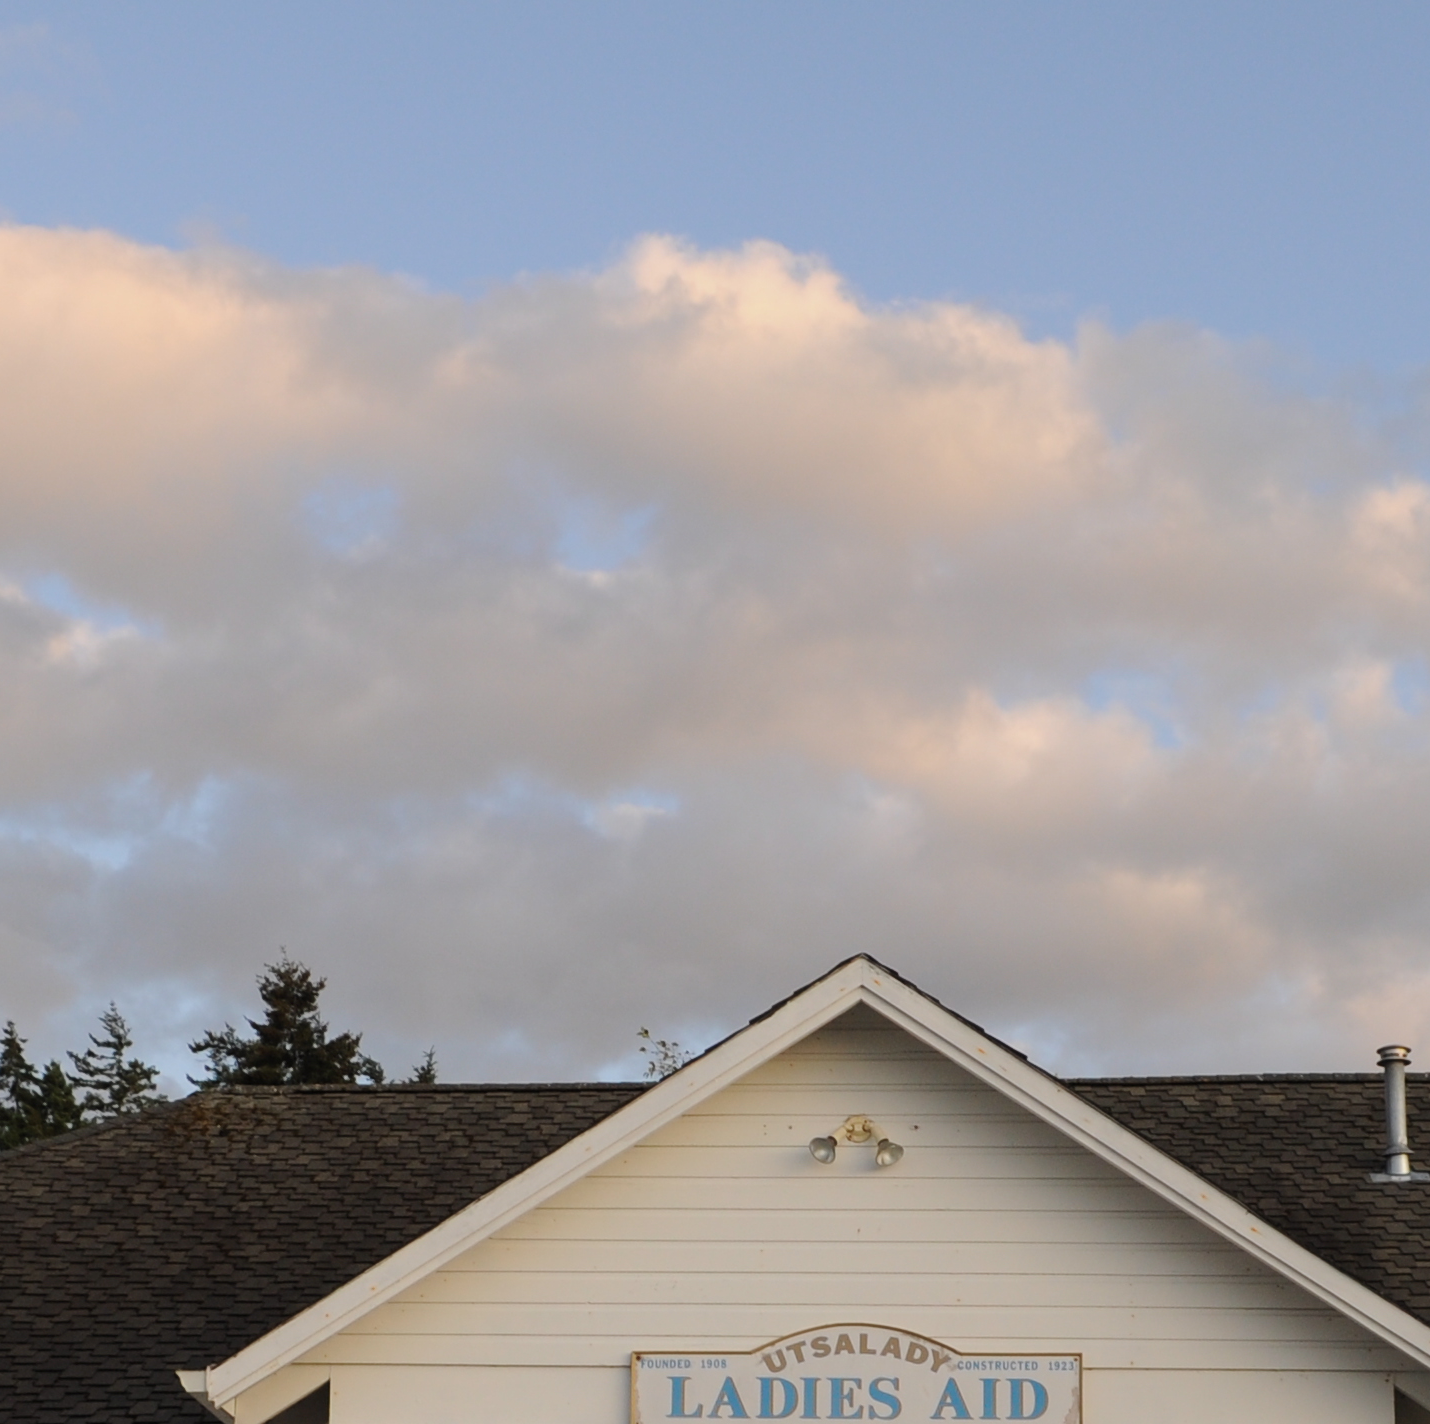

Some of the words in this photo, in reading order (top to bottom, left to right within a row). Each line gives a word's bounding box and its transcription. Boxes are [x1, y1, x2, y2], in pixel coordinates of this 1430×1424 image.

[640, 1358, 691, 1369] FOUNDED
[700, 1358, 727, 1369] 1908
[762, 1332, 953, 1374] UTSALADY
[957, 1360, 1039, 1371] CONSTRUCTED
[1048, 1360, 1075, 1371] 1923
[665, 1375, 903, 1421] LADIES
[929, 1376, 1050, 1421] AID
